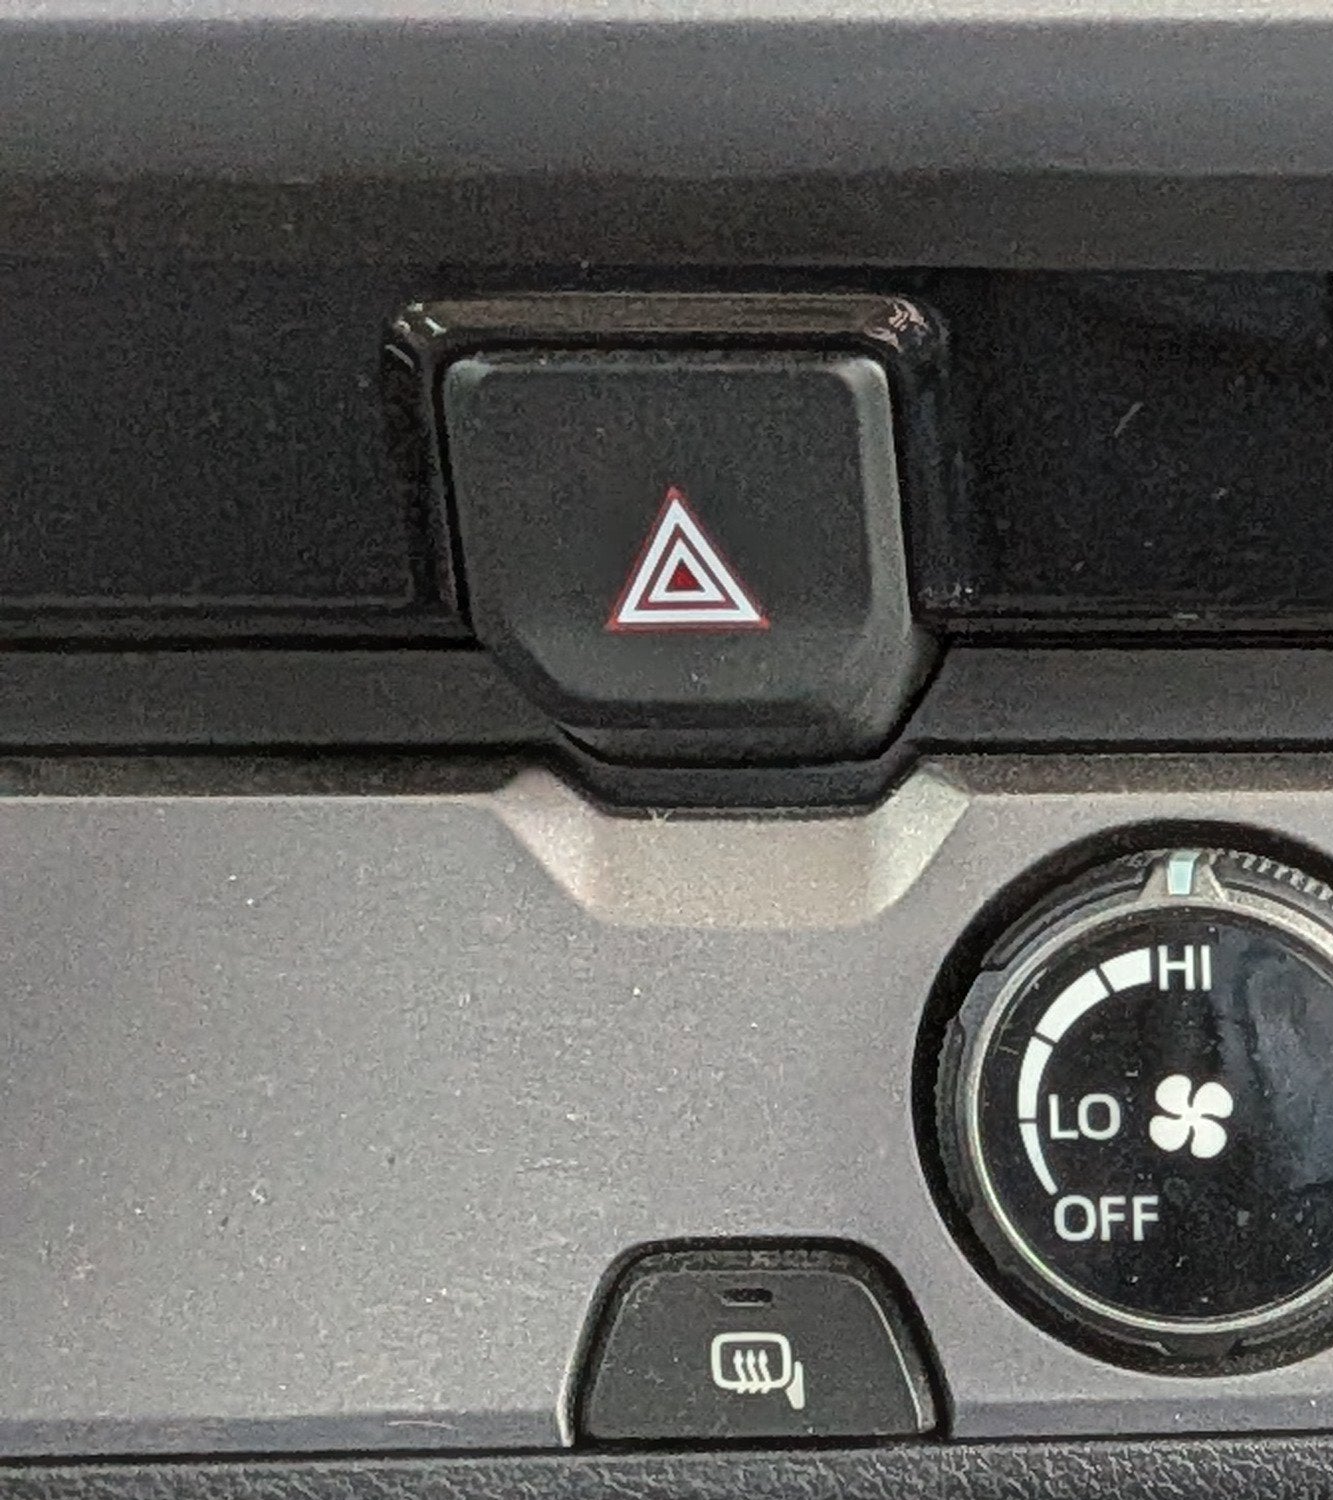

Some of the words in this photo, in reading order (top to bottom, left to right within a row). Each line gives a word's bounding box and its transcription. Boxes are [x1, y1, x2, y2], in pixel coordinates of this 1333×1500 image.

[1158, 946, 1212, 990] HI
[1047, 1095, 1121, 1140] LO
[1053, 1196, 1160, 1242] OFF
